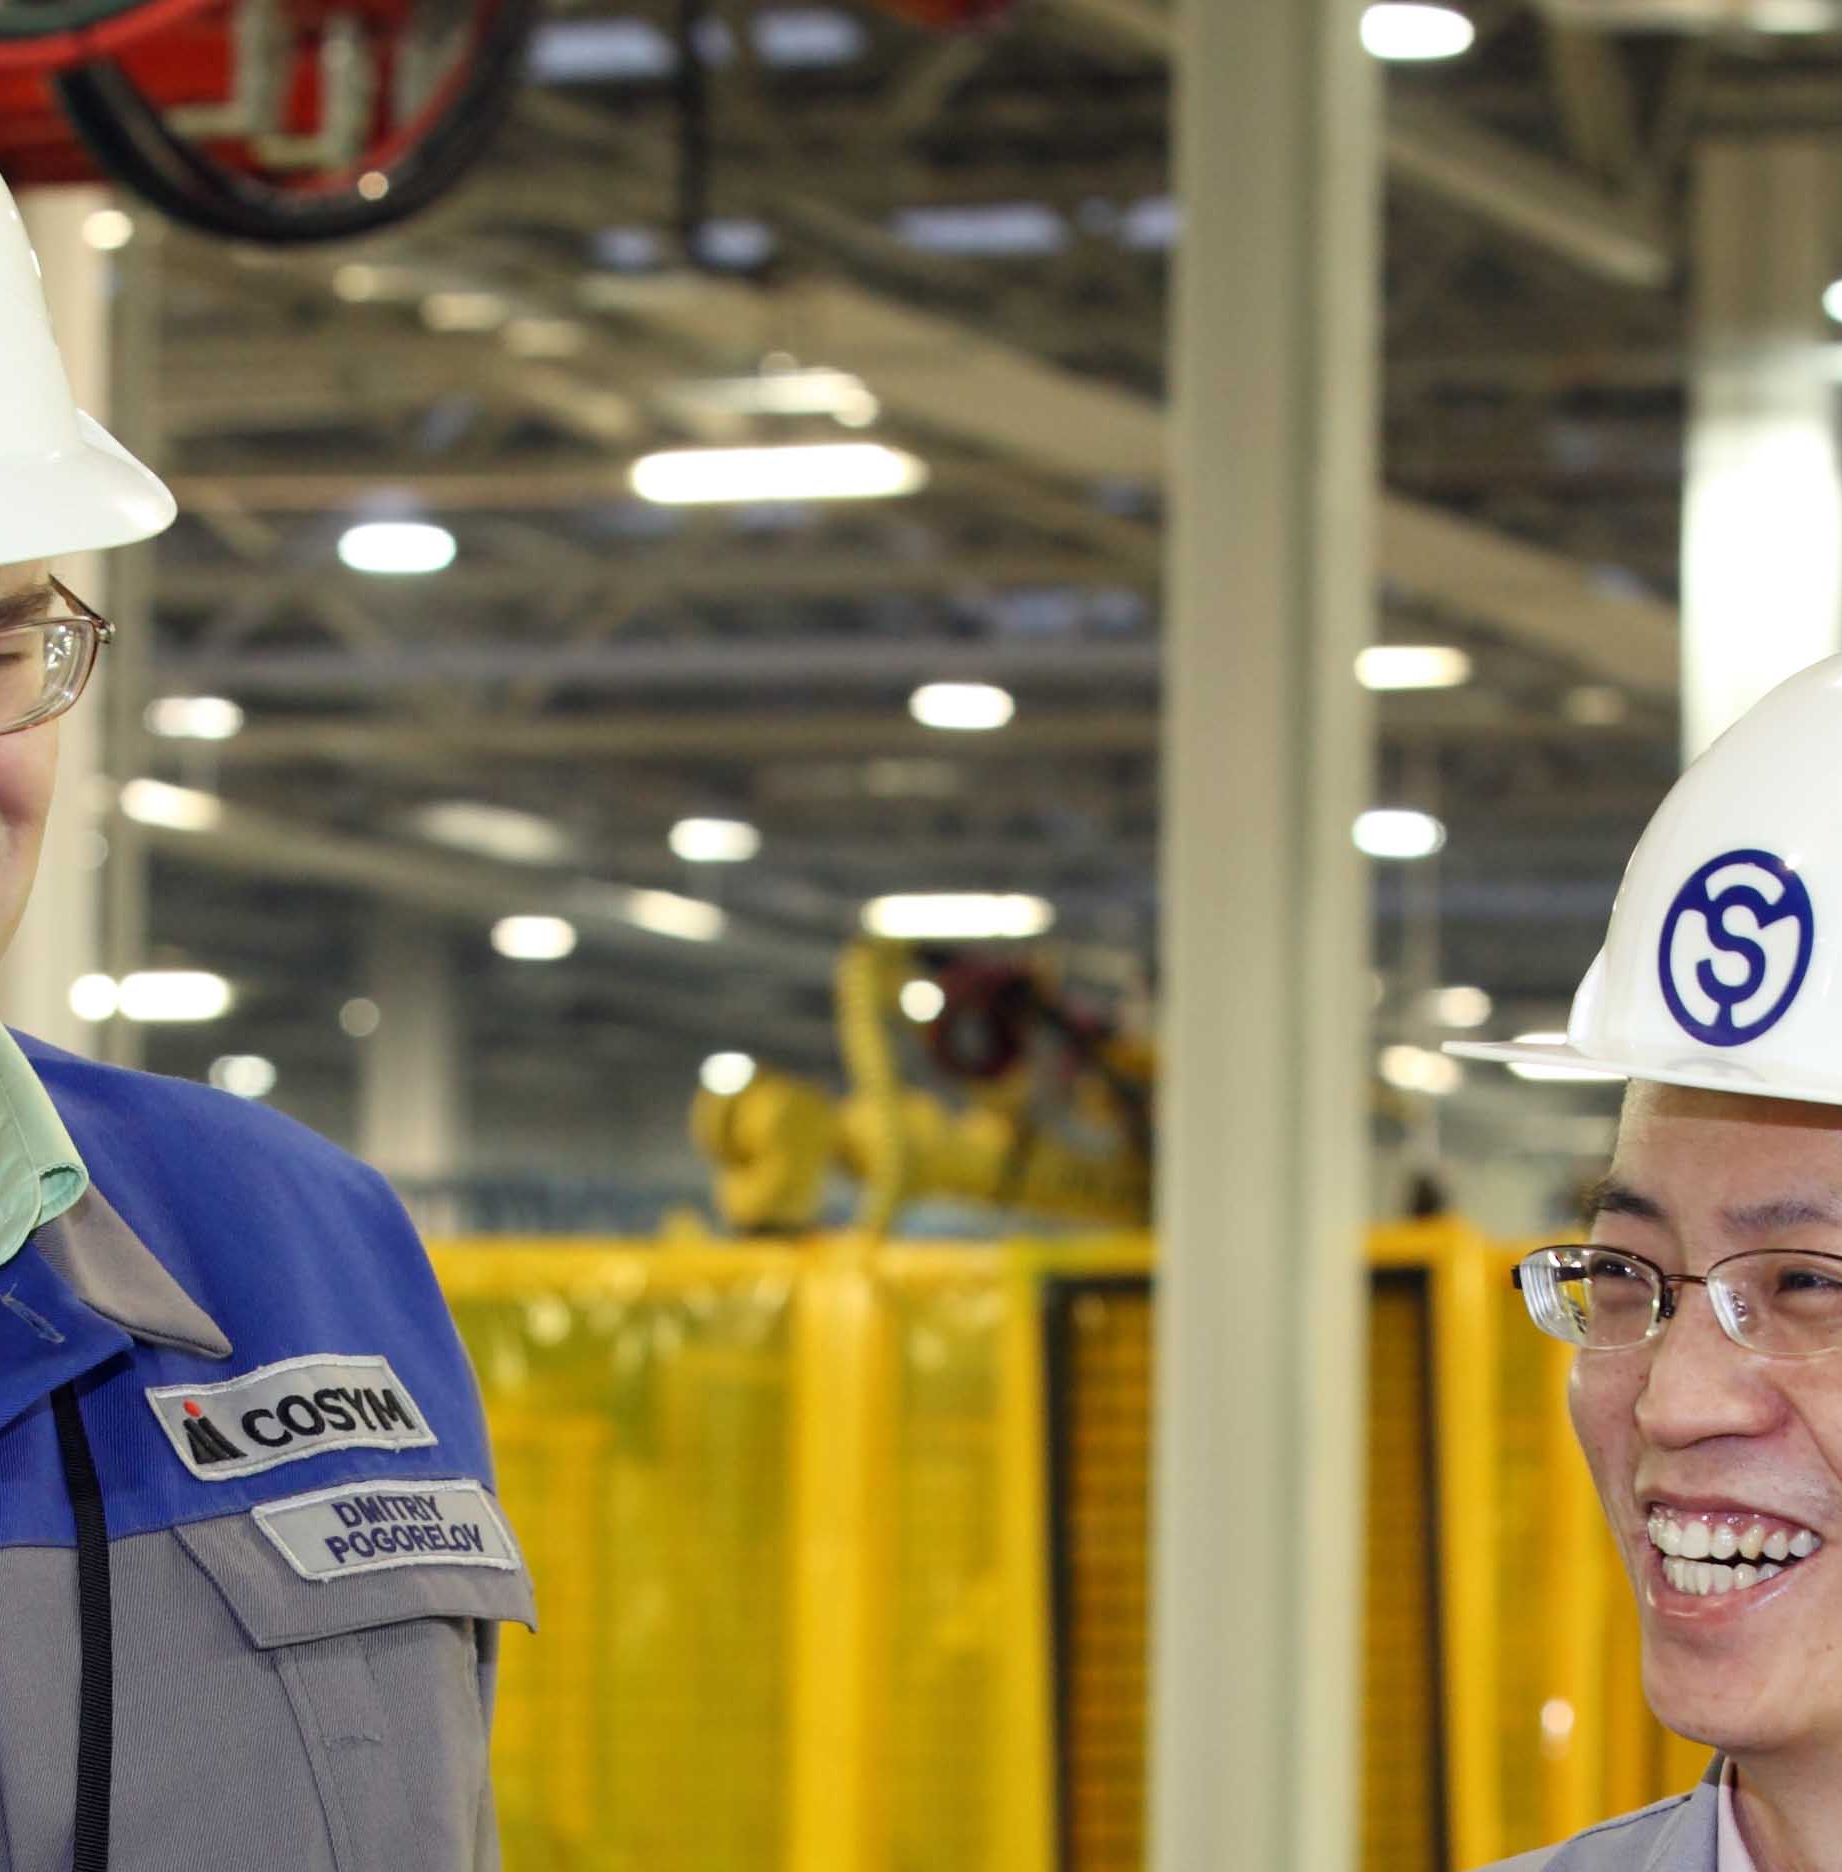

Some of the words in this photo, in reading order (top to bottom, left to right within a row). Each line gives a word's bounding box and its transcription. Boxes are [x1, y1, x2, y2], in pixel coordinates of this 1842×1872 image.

[242, 1388, 415, 1447] COSYM
[331, 1496, 443, 1528] DMITRIY
[325, 1525, 484, 1563] POGORELOV
